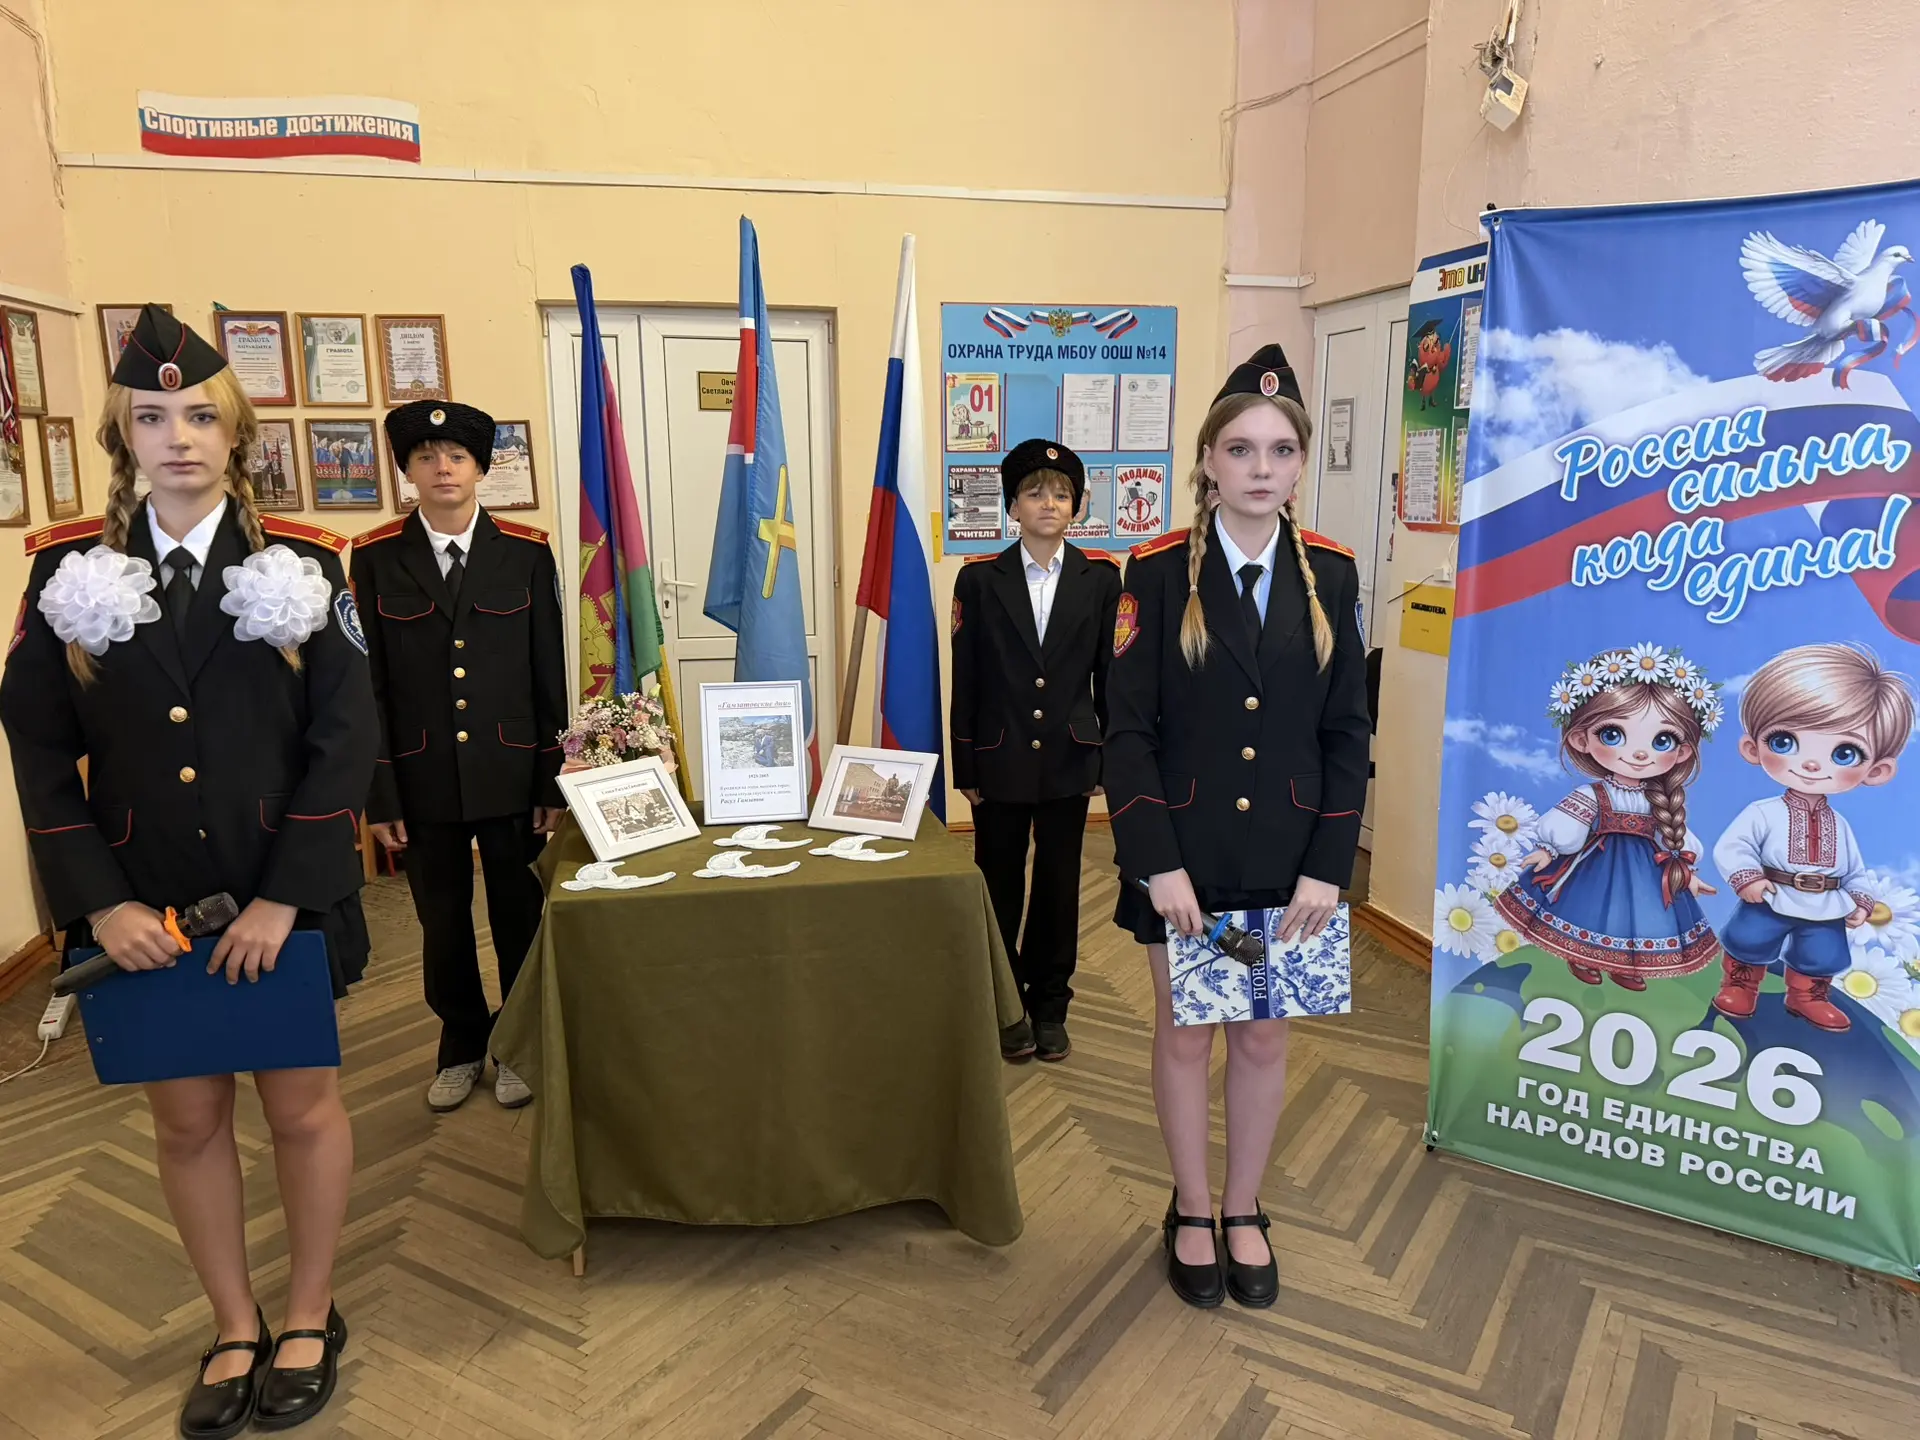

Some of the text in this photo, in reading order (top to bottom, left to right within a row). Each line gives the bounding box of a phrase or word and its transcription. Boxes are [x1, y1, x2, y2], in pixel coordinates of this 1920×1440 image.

[144, 107, 413, 141] Спортивные достижения
[948, 344, 1167, 361] ОХРАНА ТРУДА МБОУ ООШ №14
[701, 387, 733, 395] Светлана
[970, 384, 993, 412] 01
[1118, 468, 1162, 484] УХОДИШЬ
[1554, 405, 1767, 501] Россия
[1667, 422, 1911, 514] сильна,
[1117, 516, 1161, 532] ВЫКЛЮЧИ
[1571, 516, 1725, 591] когда
[1684, 493, 1911, 624] едина!
[1250, 929, 1267, 1000] FIOREO
[1517, 996, 1823, 1126] 2026
[1486, 1102, 1857, 1220] НАРОДОВ РОССИИ
[1517, 1076, 1824, 1175] ГОД ЕДИНСТВА
